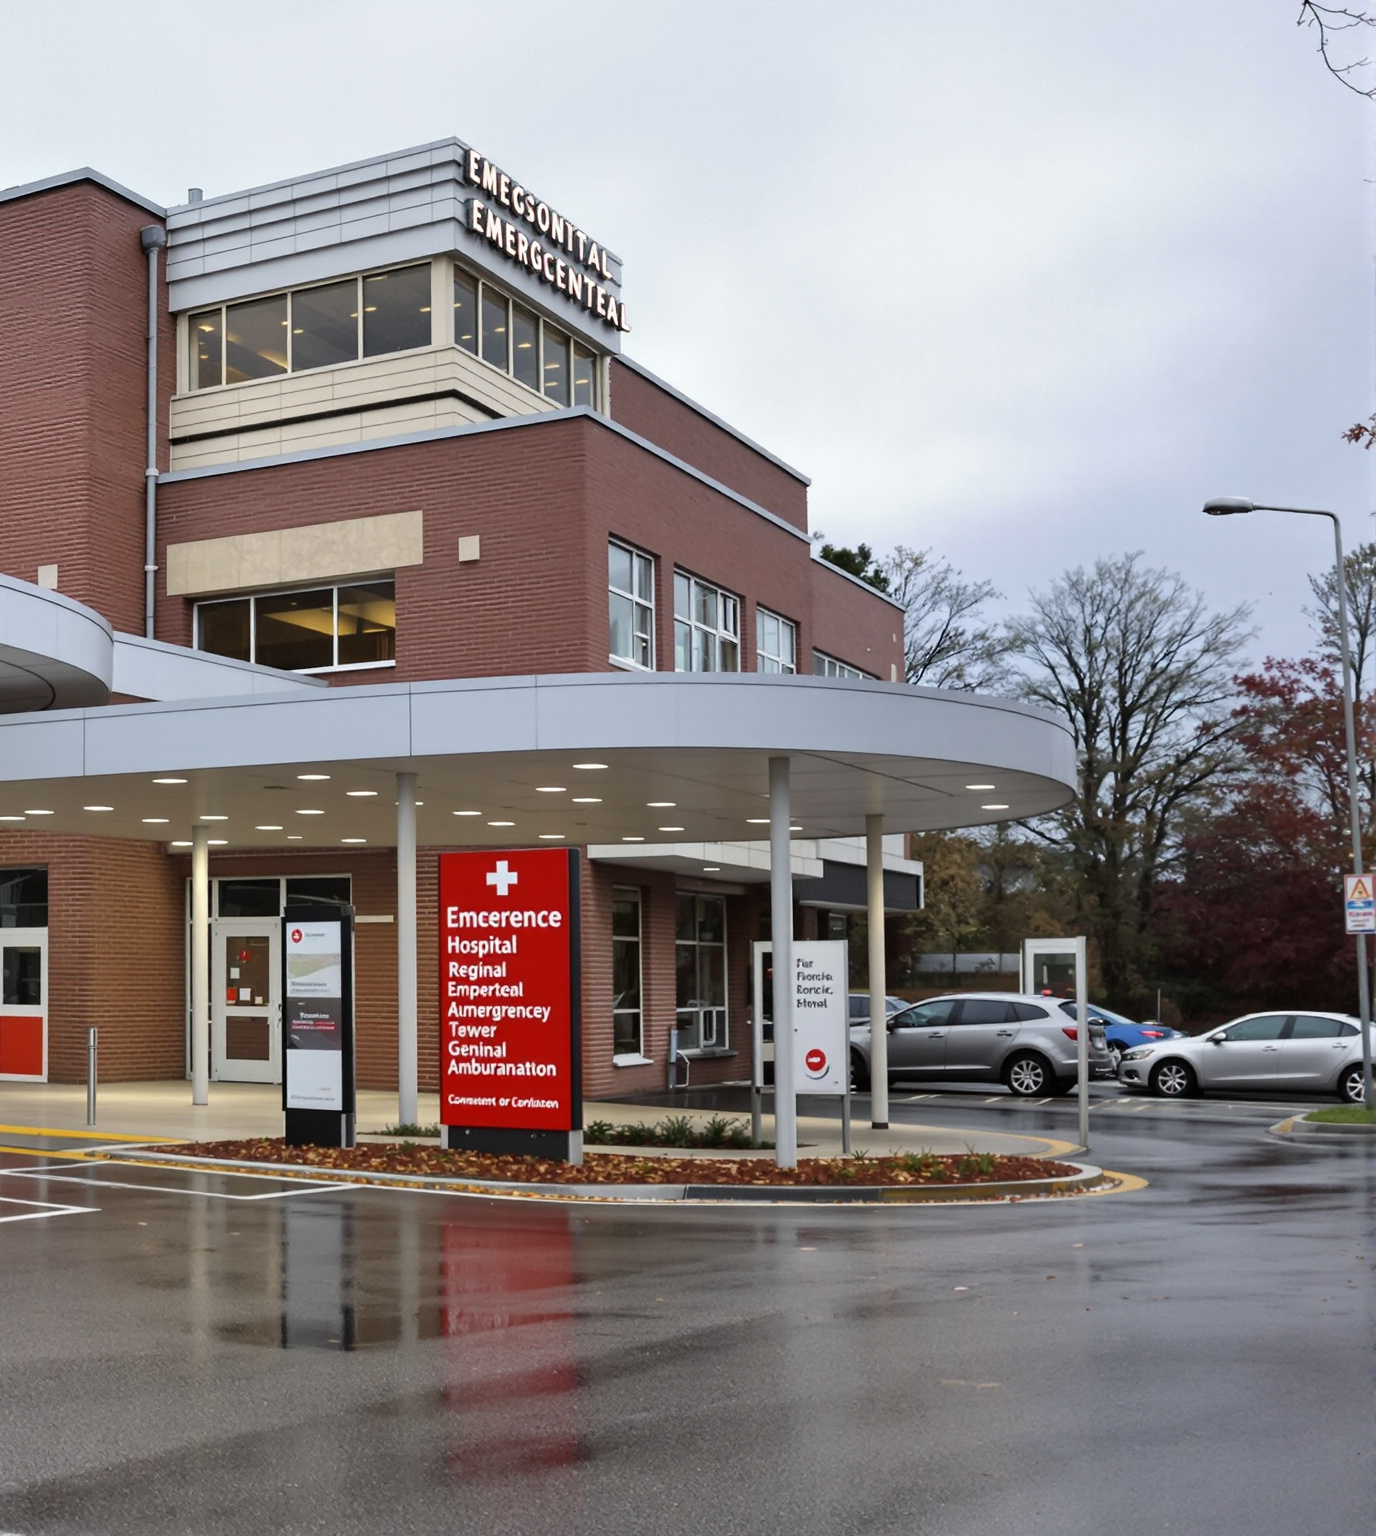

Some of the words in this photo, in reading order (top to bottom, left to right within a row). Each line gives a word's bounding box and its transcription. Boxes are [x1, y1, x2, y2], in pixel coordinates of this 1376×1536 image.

[447, 906, 562, 928] Emcerence
[447, 934, 517, 958] Hospital
[449, 961, 506, 981] Reginal
